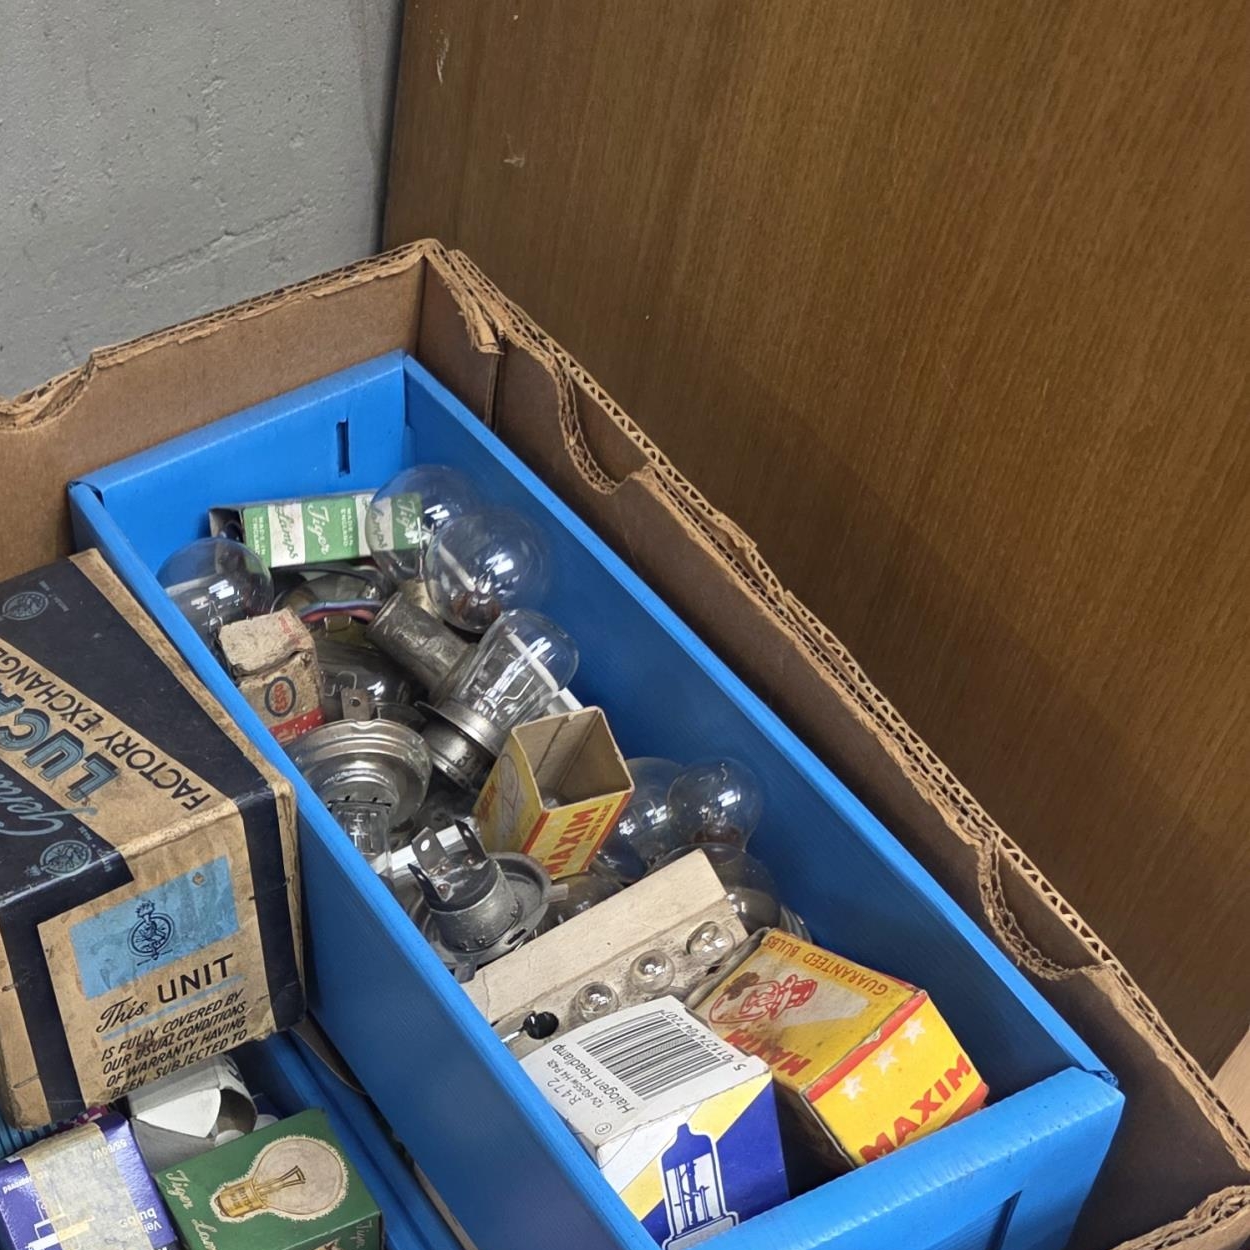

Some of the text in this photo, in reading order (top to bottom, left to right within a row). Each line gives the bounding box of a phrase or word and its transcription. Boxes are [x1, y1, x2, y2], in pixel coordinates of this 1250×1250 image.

[274, 504, 298, 559] Lamps
[307, 504, 331, 556] Tiger
[95, 730, 211, 810] FACTORY
[96, 953, 233, 1033] This UNIT
[764, 935, 888, 996] GUARANTEED BULBS
[101, 988, 244, 1062] IS FULLY COVERED BY
[103, 1001, 246, 1075] OUR USUAL CONDITIONS
[106, 1016, 246, 1088] OF WARRANTY HAVING
[110, 1029, 248, 1099] BEEN SUBJECTED TO
[547, 1079, 582, 1106] R472
[552, 1044, 634, 1114] Halogen Headlamp
[733, 1063, 747, 1072] 5
[858, 1054, 972, 1163] MAXIM
[165, 1169, 194, 1210] Tiger
